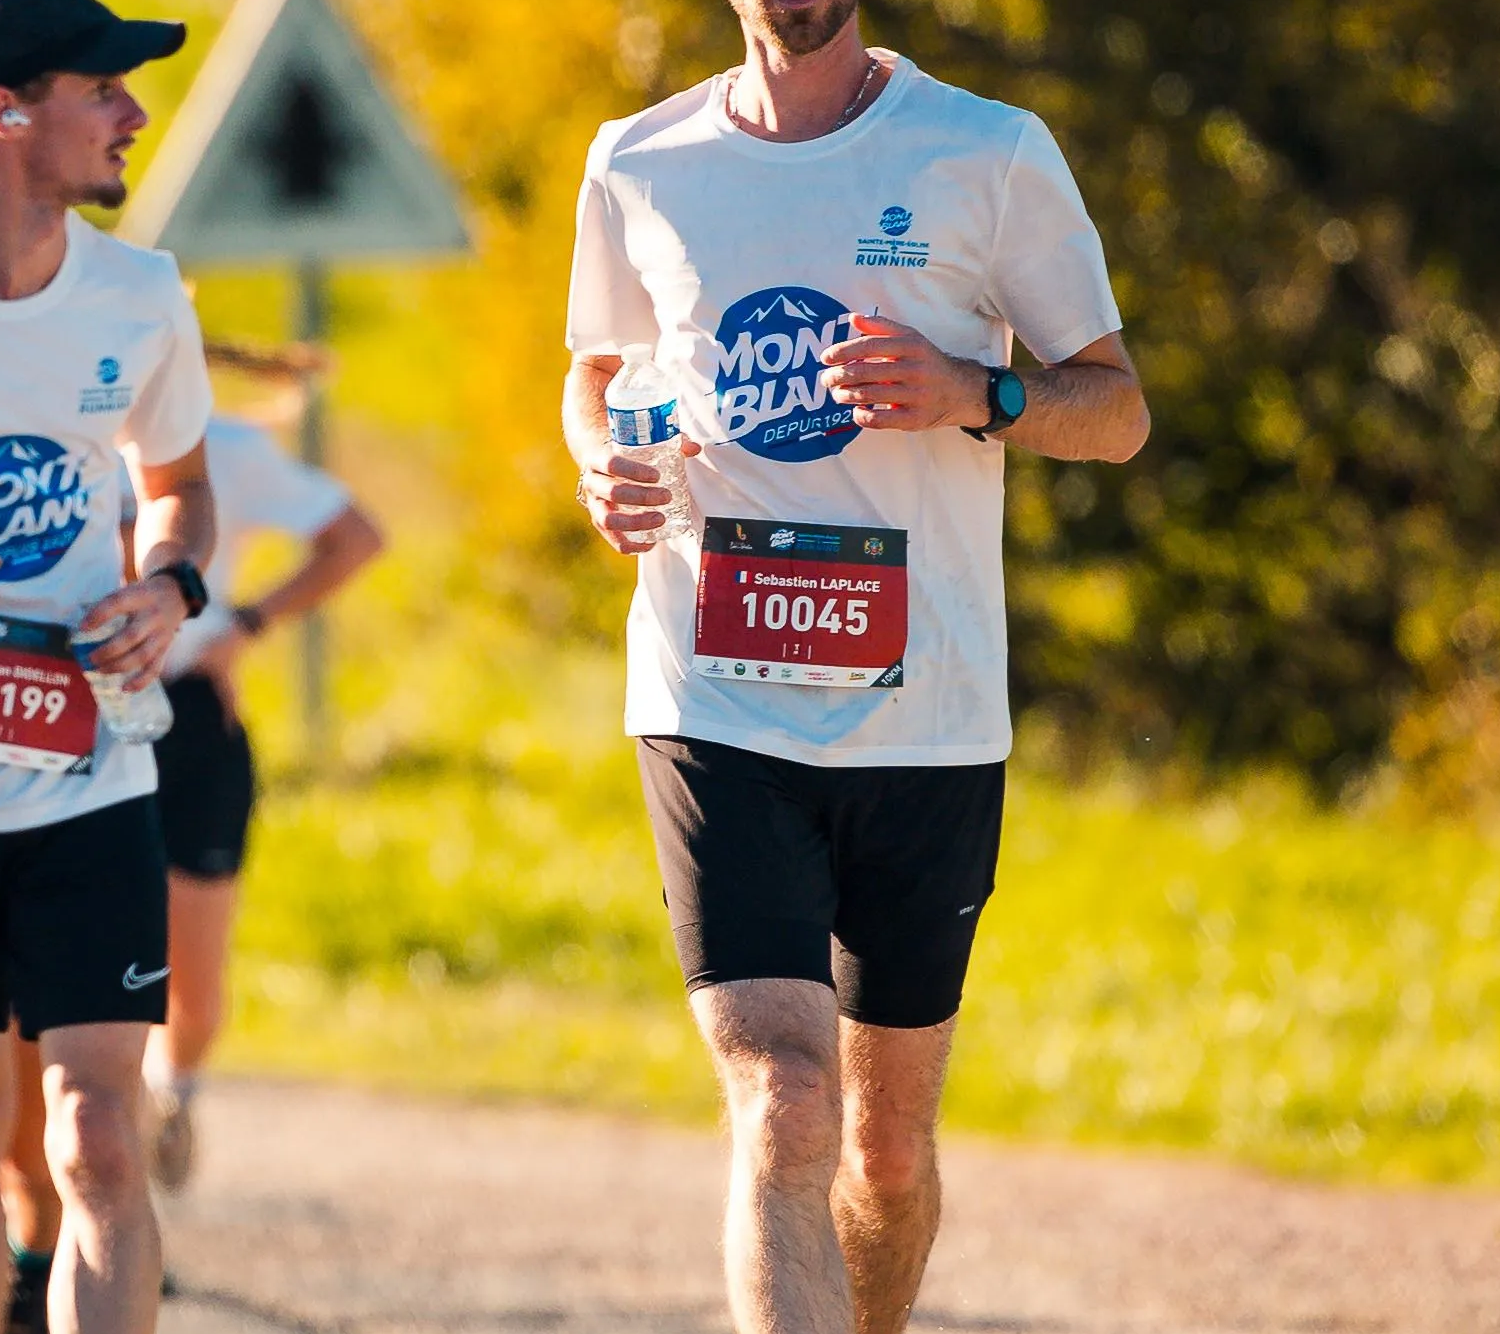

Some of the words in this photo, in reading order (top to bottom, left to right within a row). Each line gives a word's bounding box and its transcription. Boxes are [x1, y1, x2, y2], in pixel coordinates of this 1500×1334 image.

[856, 254, 928, 268] RUNNING
[718, 370, 829, 439] BLA
[824, 410, 852, 428] 192
[754, 572, 817, 589] Sebastien
[820, 577, 881, 593] LAPLACE
[742, 592, 869, 636] 10045
